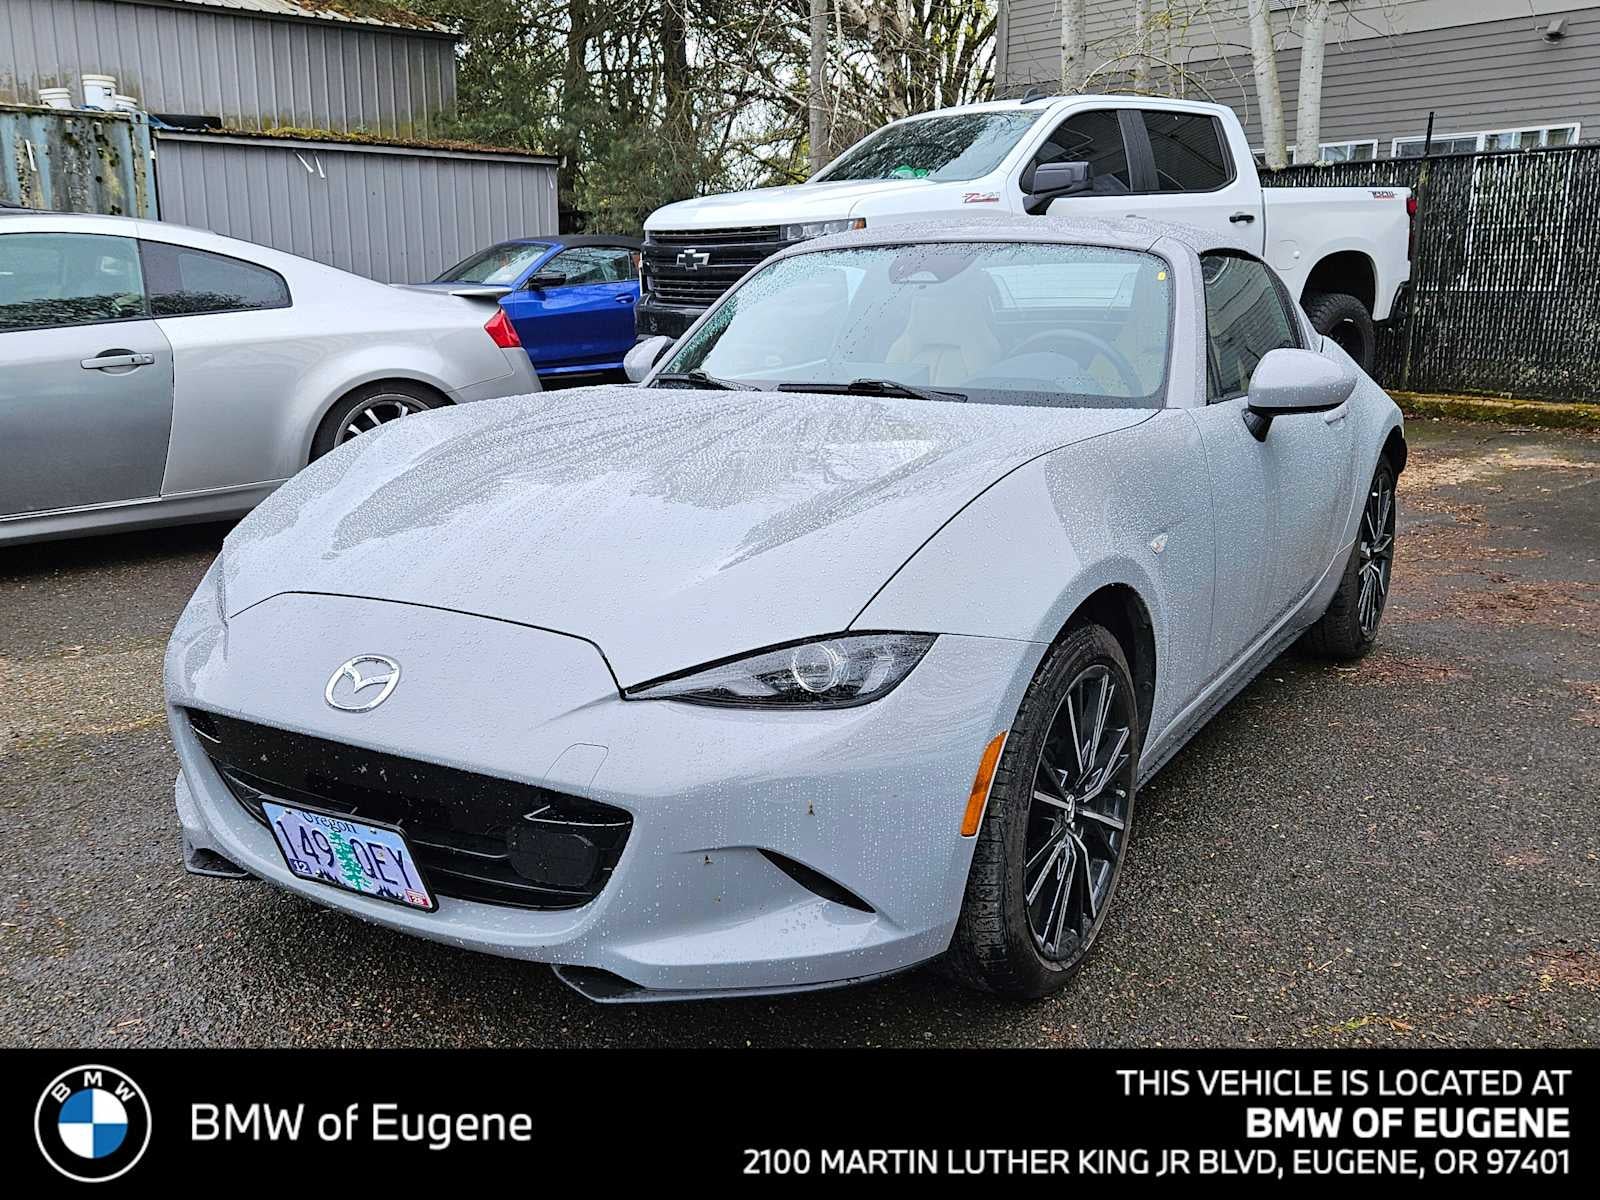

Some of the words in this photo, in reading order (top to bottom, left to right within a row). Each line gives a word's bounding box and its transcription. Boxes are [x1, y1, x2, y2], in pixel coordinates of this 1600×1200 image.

[302, 810, 359, 833] Oregon
[276, 820, 335, 867] 149
[349, 838, 413, 889] QEY
[293, 860, 309, 873] 12
